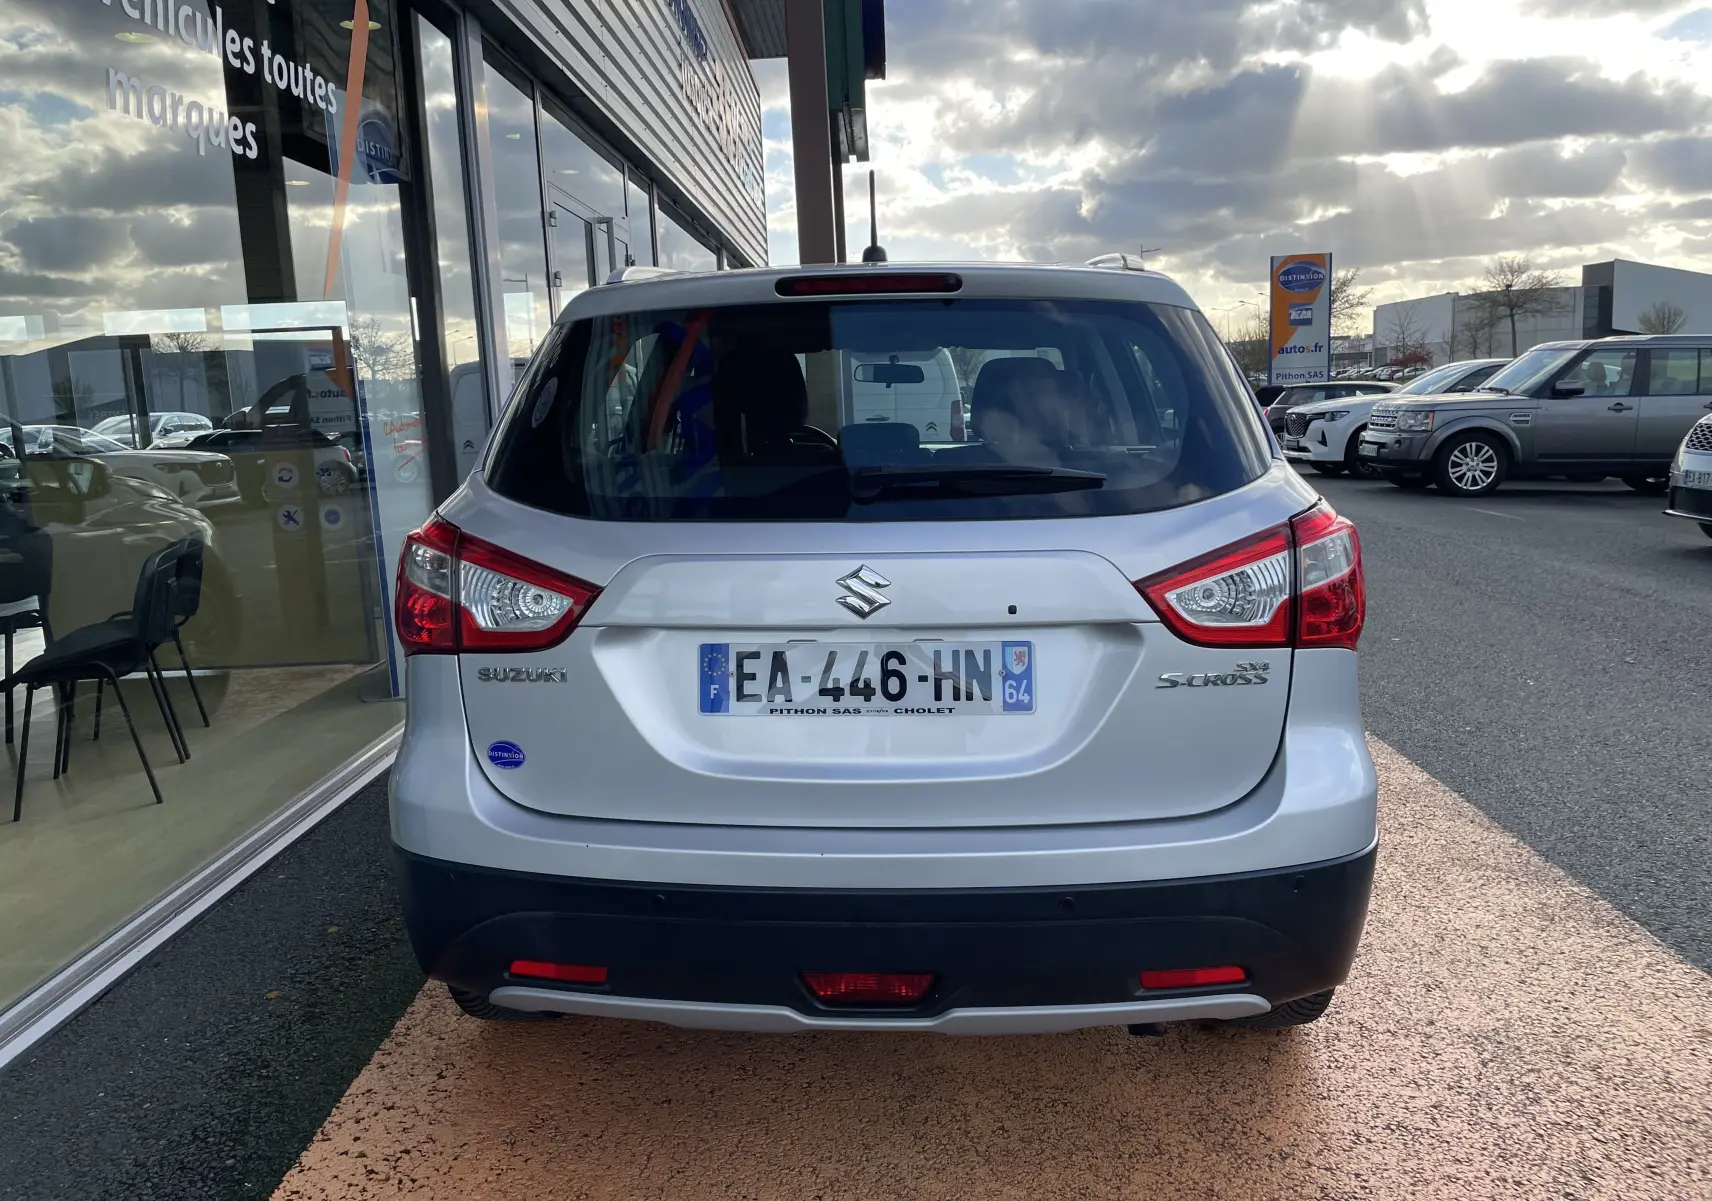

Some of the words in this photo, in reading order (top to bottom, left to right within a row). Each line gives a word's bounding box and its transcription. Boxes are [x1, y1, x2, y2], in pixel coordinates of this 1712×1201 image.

[99, 0, 256, 74] icules
[260, 39, 337, 114] toutes
[106, 67, 258, 160] marques
[1277, 342, 1324, 355] autos.fr
[1275, 373, 1305, 381] Pithon
[1307, 371, 1324, 379] SAS
[1234, 661, 1270, 672] SX4
[477, 667, 568, 683] SUZUKI
[1155, 672, 1270, 689] S-CROSS
[710, 684, 719, 699] F
[1004, 679, 1031, 704] 64
